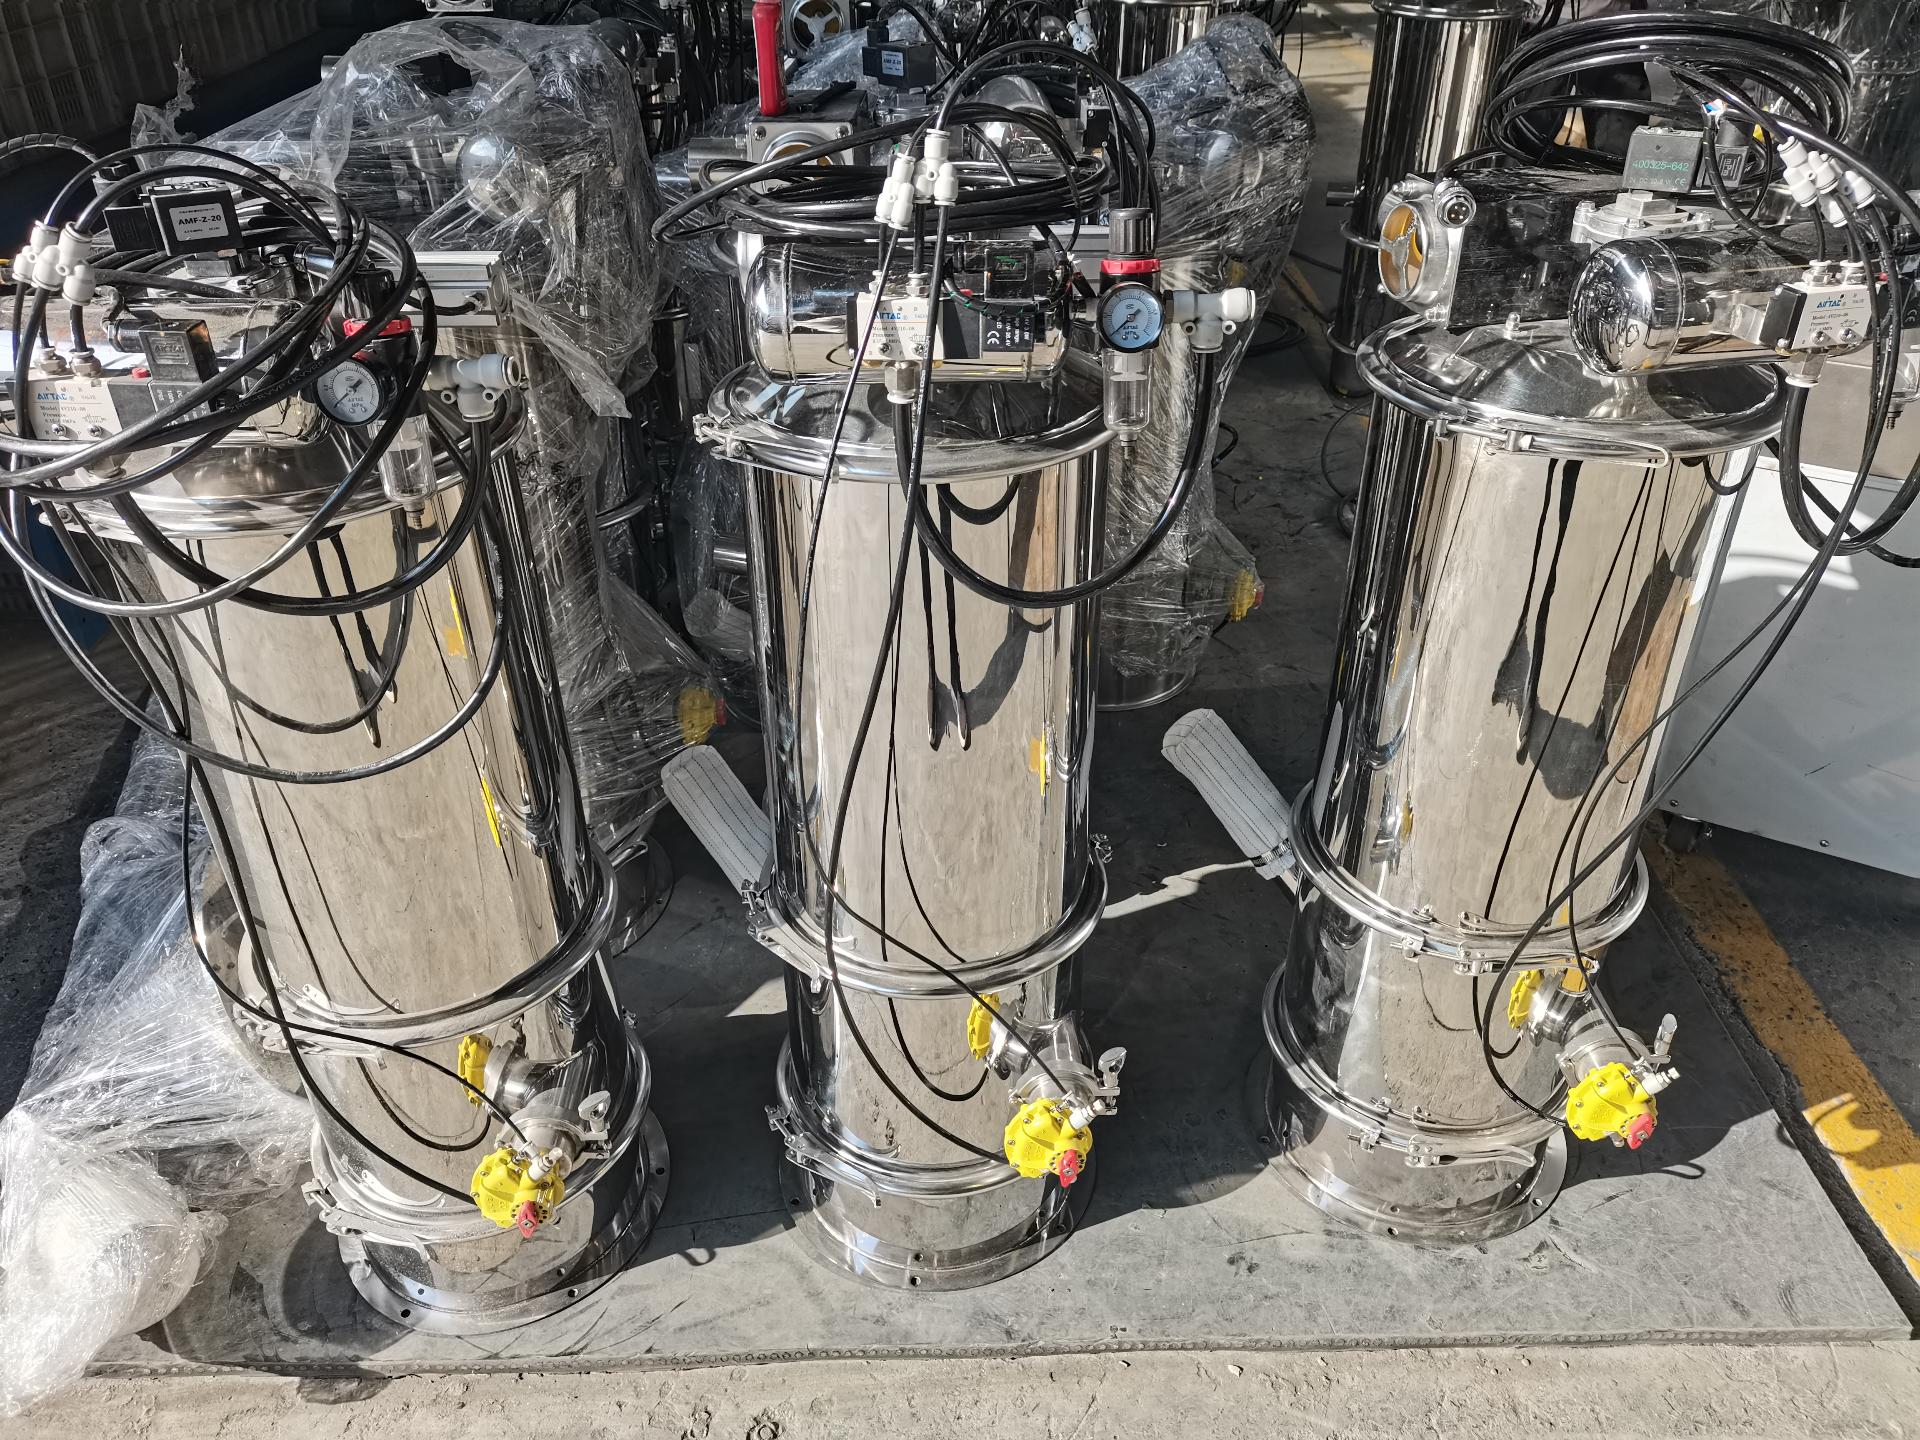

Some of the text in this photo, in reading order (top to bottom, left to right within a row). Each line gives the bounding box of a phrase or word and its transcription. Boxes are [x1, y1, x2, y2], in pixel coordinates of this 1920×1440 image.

[1632, 159, 1689, 172] 400325-642
[178, 214, 222, 226] AMF-Z-20
[1904, 309, 1918, 323] CE
[986, 330, 1000, 345] CE
